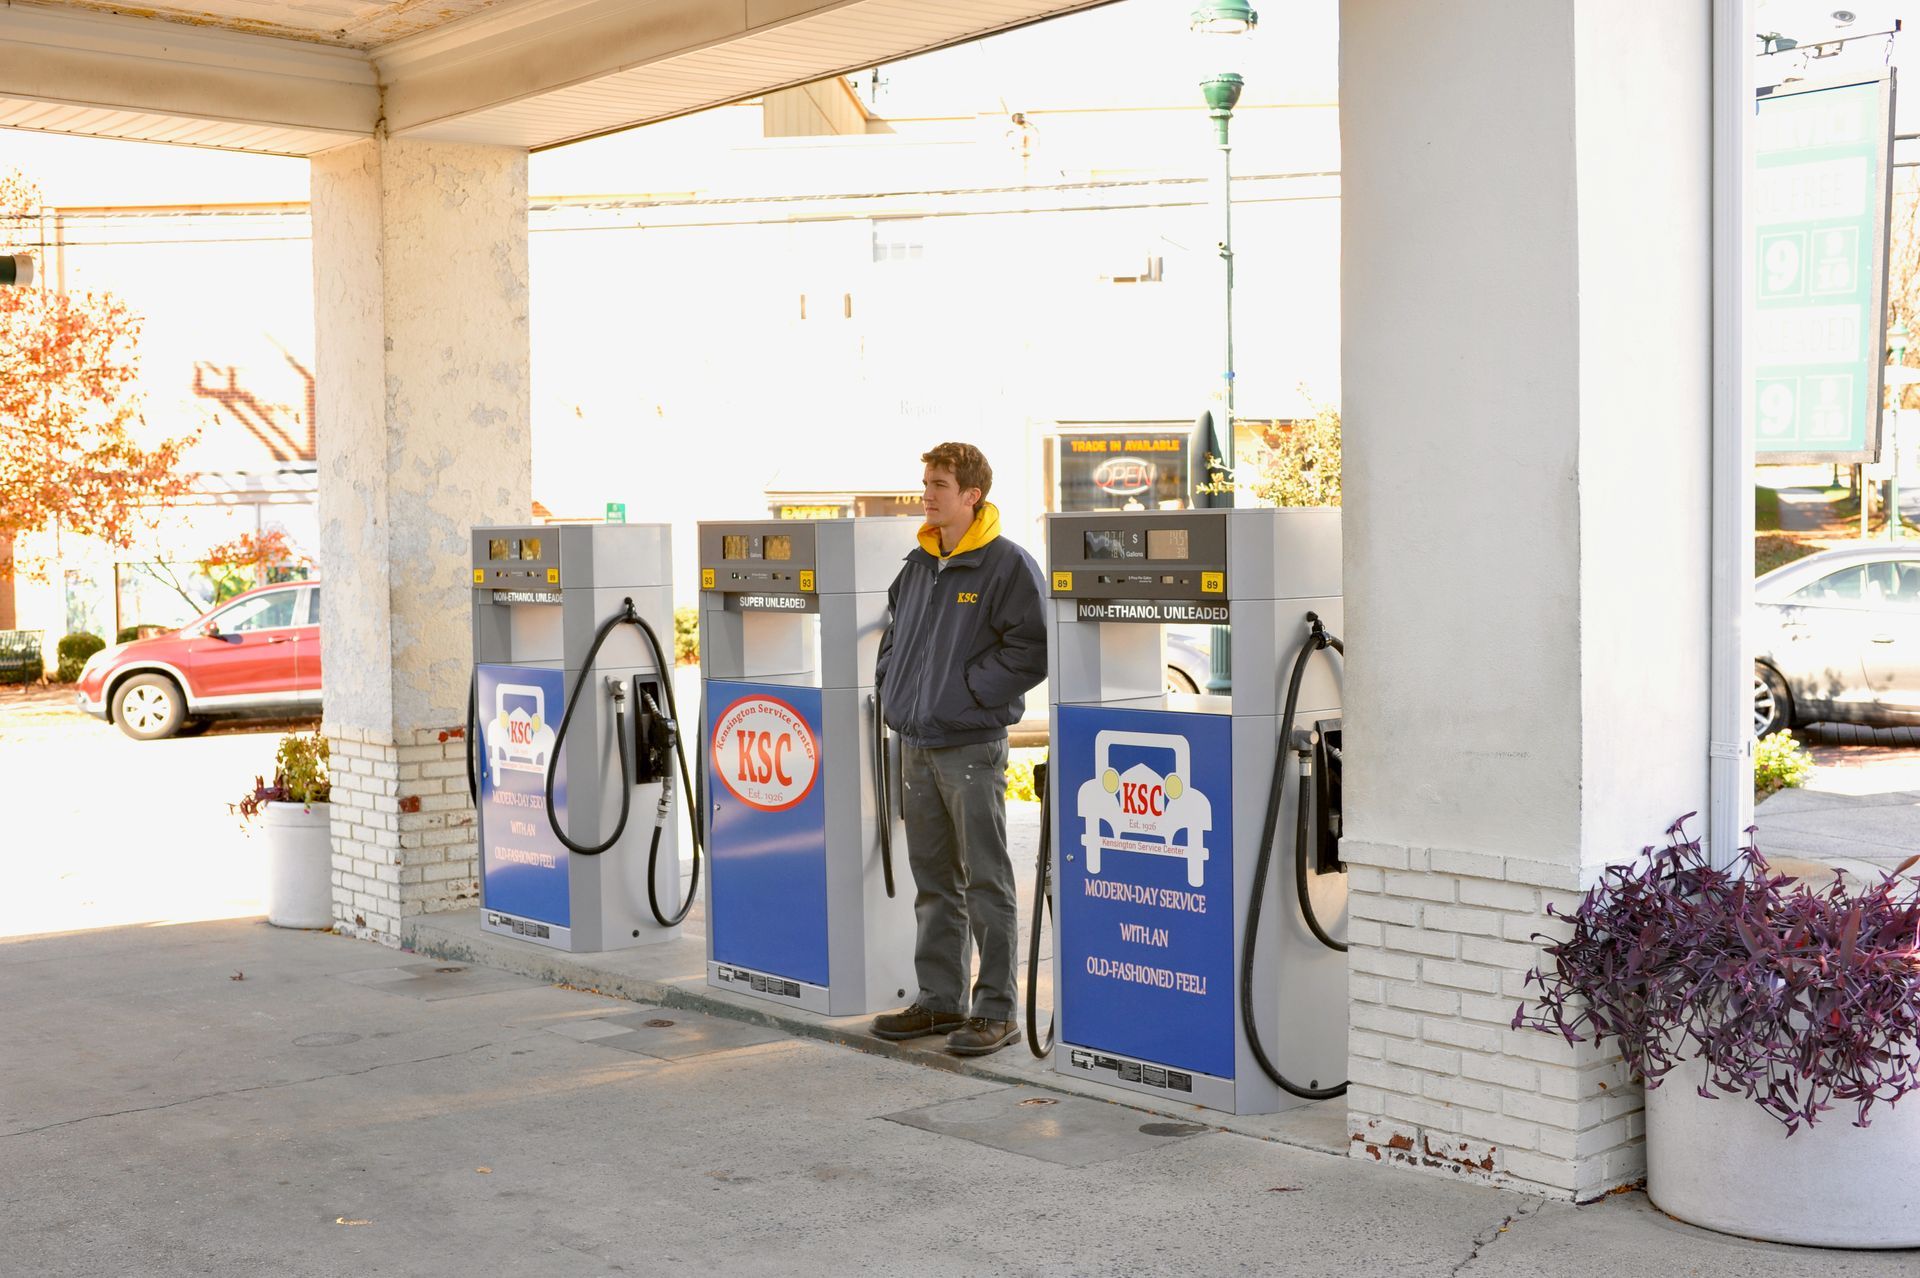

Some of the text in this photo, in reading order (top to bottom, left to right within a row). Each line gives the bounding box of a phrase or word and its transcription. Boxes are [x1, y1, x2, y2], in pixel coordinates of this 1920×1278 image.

[1765, 239, 1799, 291] 9
[1759, 382, 1794, 436] 9
[1071, 440, 1180, 452] TRADE IN AVAILABLE
[1094, 464, 1155, 488] OPEN
[1132, 533, 1139, 544] $
[704, 577, 713, 585] 93
[802, 579, 811, 587] 93
[1057, 579, 1068, 588] 89
[1206, 580, 1219, 589] 89
[493, 592, 563, 603] NON-ETHANOL UNLEADE
[740, 596, 806, 609] SUPER UNLEADED
[957, 592, 978, 603] KSC
[1079, 604, 1229, 620] NON-ETHANOL UNLEADED
[510, 720, 531, 744] KSC
[716, 703, 815, 760] Kensington Service Center
[736, 730, 792, 787] KSC
[748, 788, 784, 803] Est. 1926
[1122, 782, 1163, 816] KSC
[1129, 818, 1157, 831] Est. 1926
[1102, 838, 1185, 855] Kensington Service Center
[1085, 878, 1206, 913] MODERN-DAY SERVICE
[1120, 922, 1168, 948] WITH AN
[1086, 956, 1207, 995] OLD-FASHIONED FEEL!
